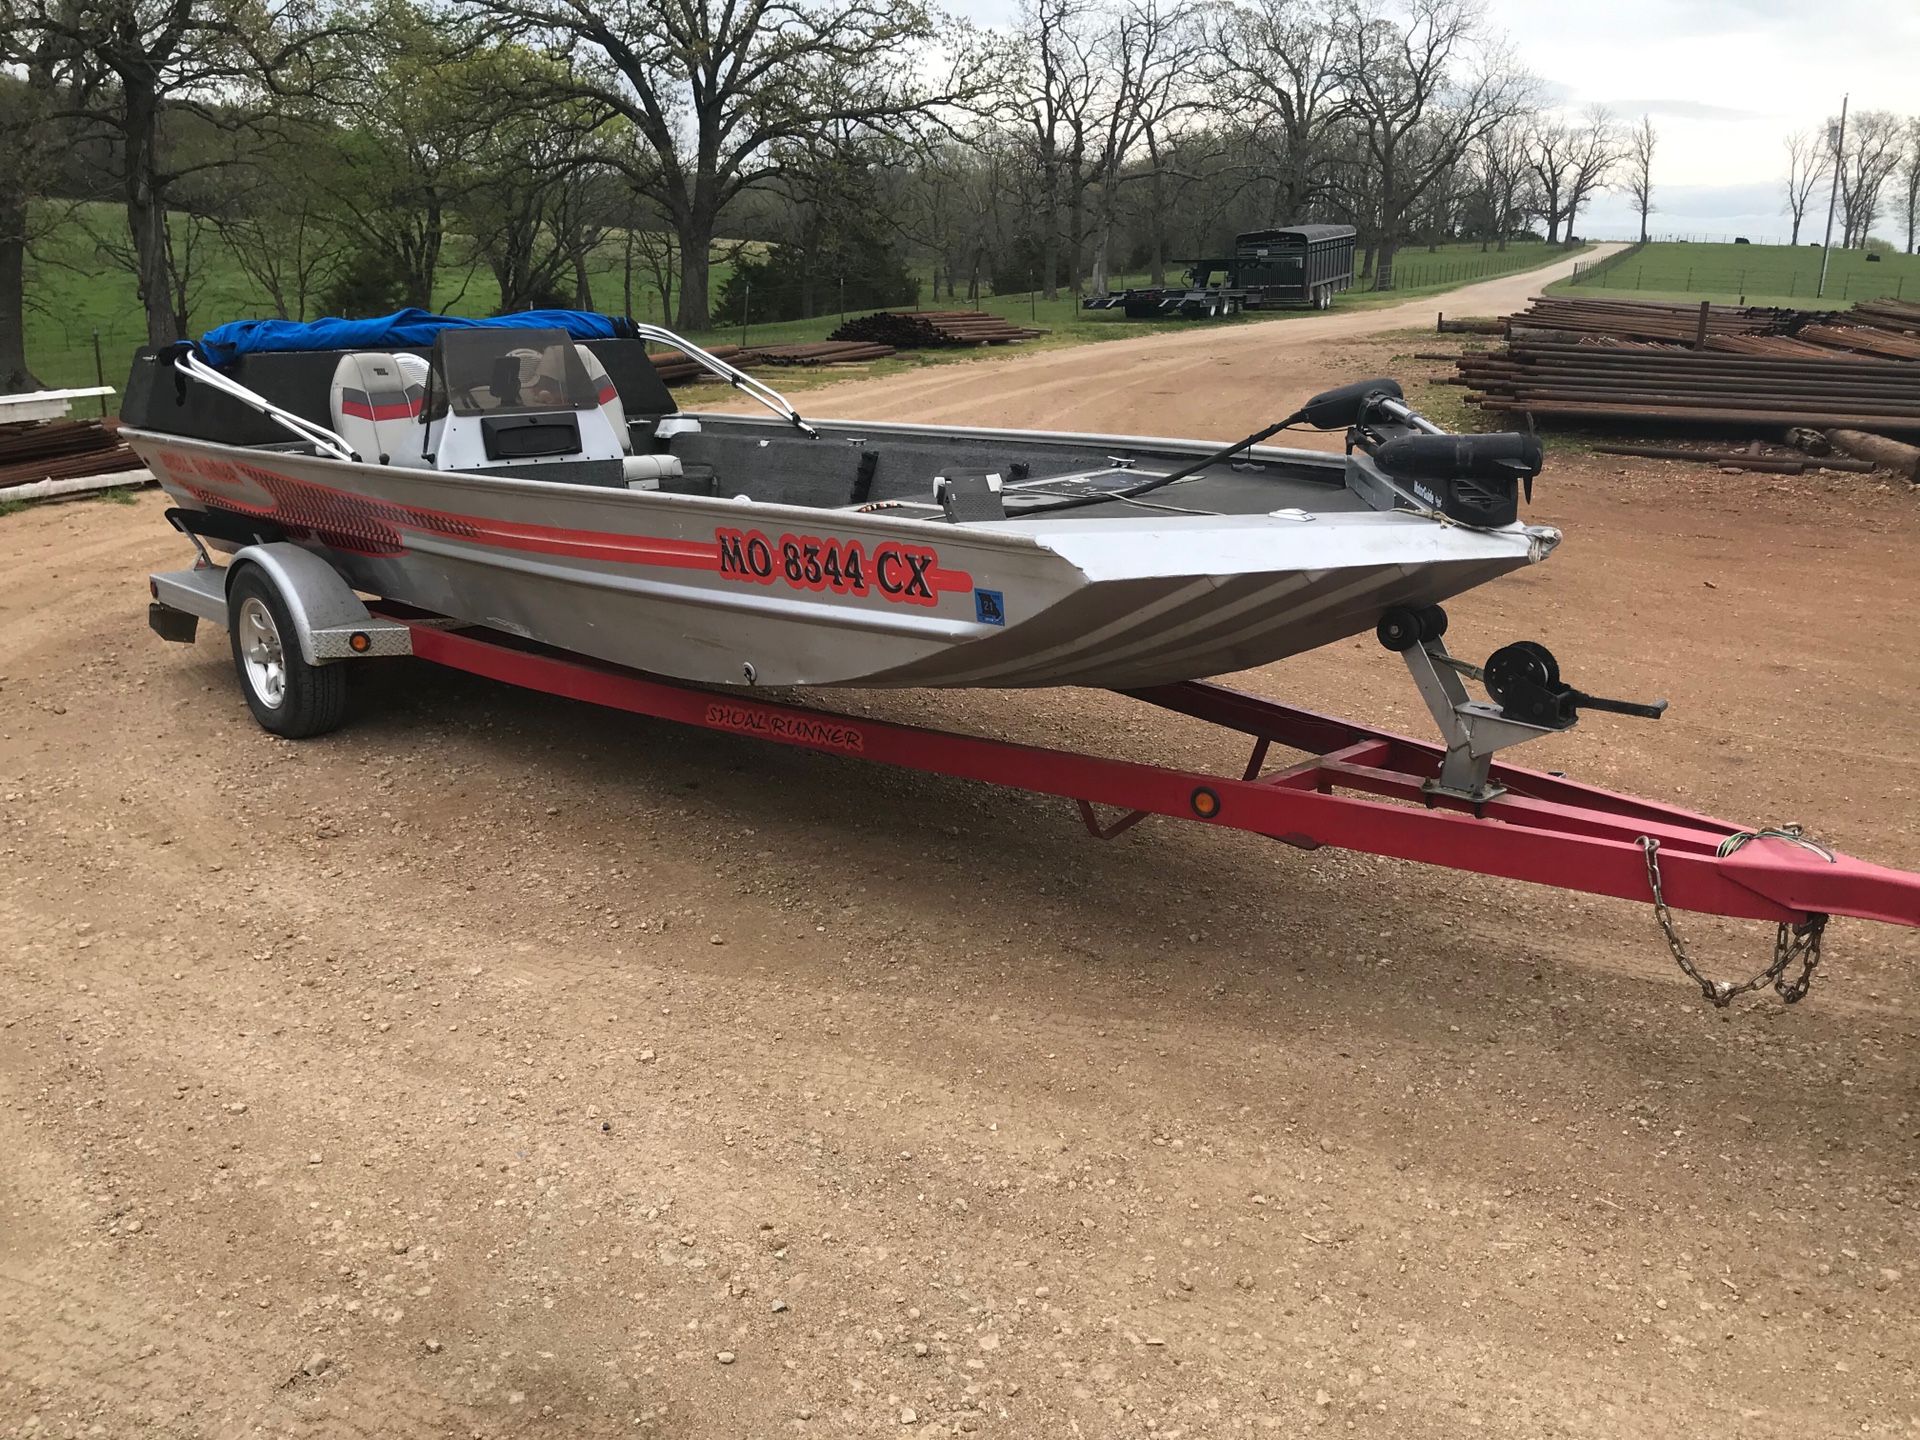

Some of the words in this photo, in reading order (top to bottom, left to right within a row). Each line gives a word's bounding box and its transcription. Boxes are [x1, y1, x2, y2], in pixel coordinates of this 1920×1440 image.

[720, 535, 772, 577] MO
[783, 542, 865, 588] 8344
[877, 551, 933, 598] CX
[708, 707, 767, 730] SHOAL
[771, 717, 862, 747] RUNNER
